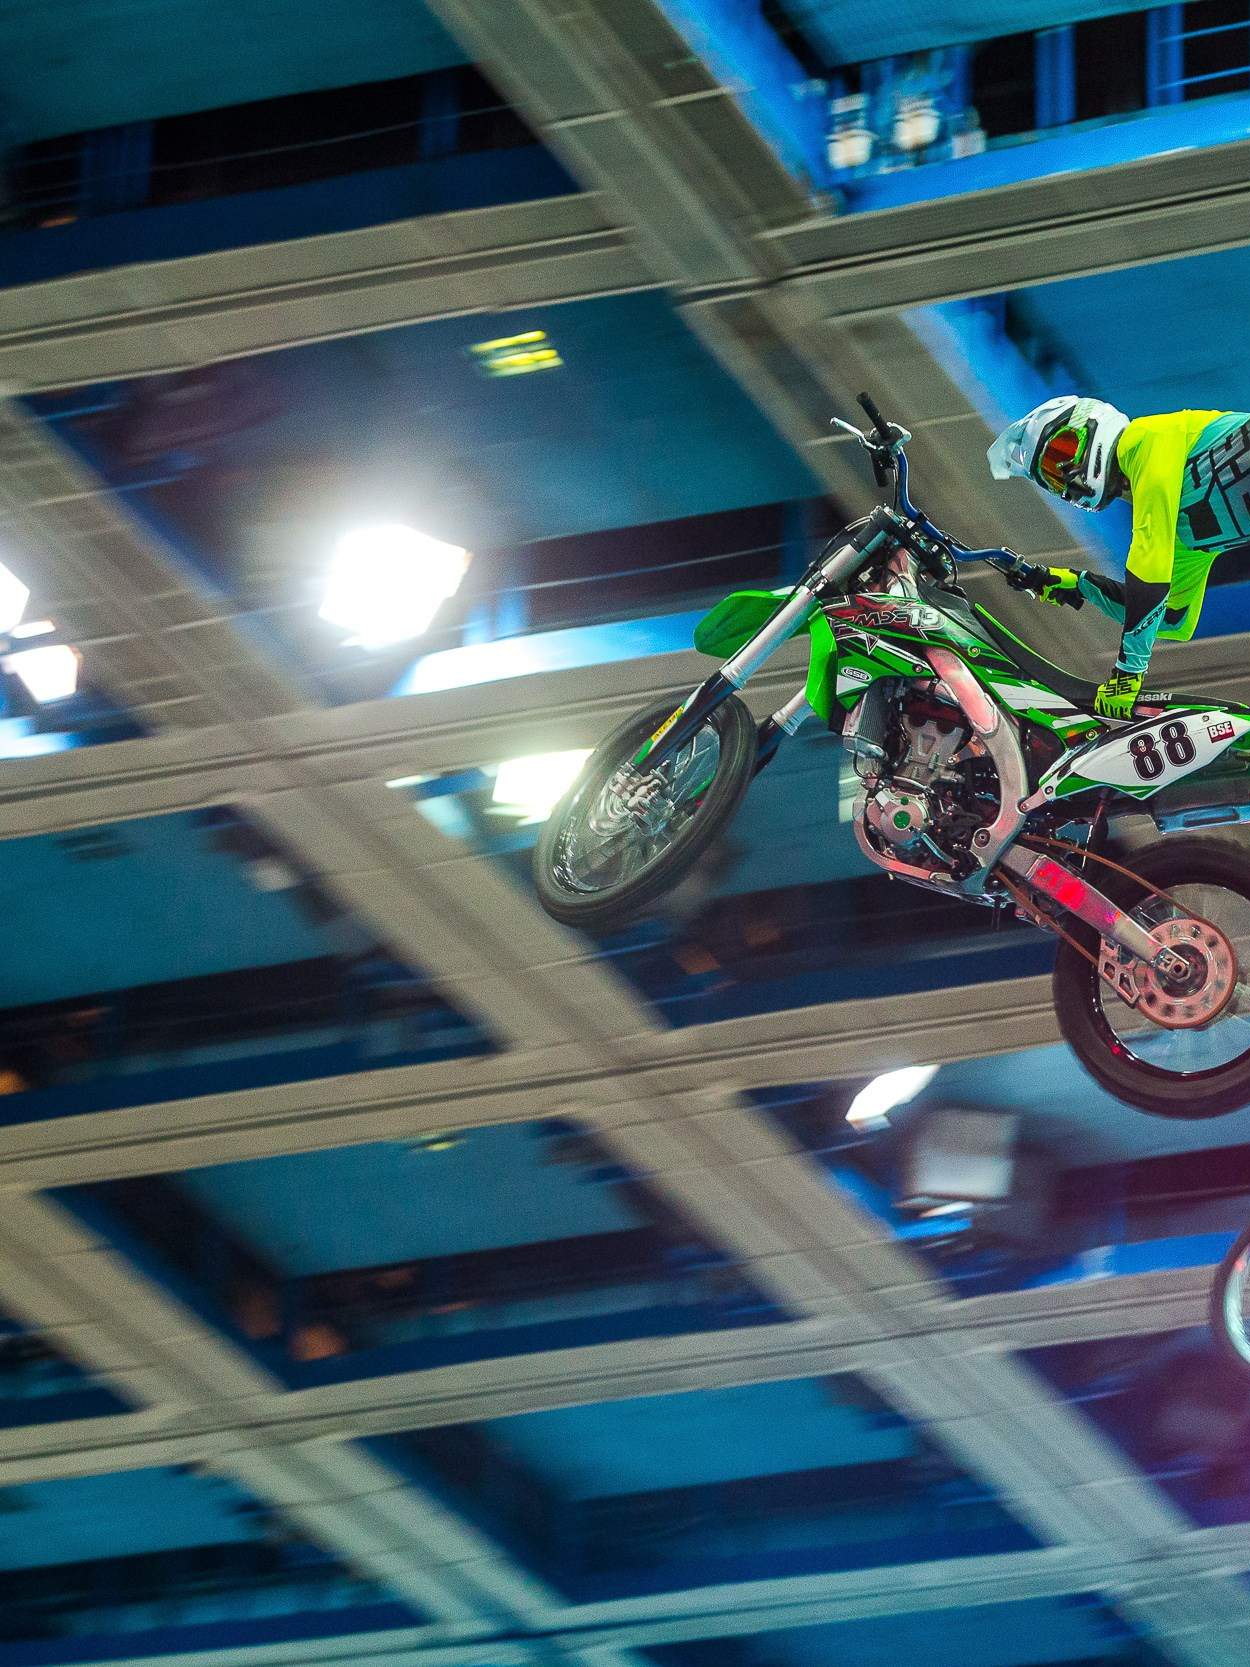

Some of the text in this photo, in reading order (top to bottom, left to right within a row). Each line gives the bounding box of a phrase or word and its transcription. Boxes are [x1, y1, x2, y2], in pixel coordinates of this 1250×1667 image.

[1137, 693, 1173, 702] asaki
[1209, 721, 1232, 737] BSE
[1127, 719, 1197, 781] 88
